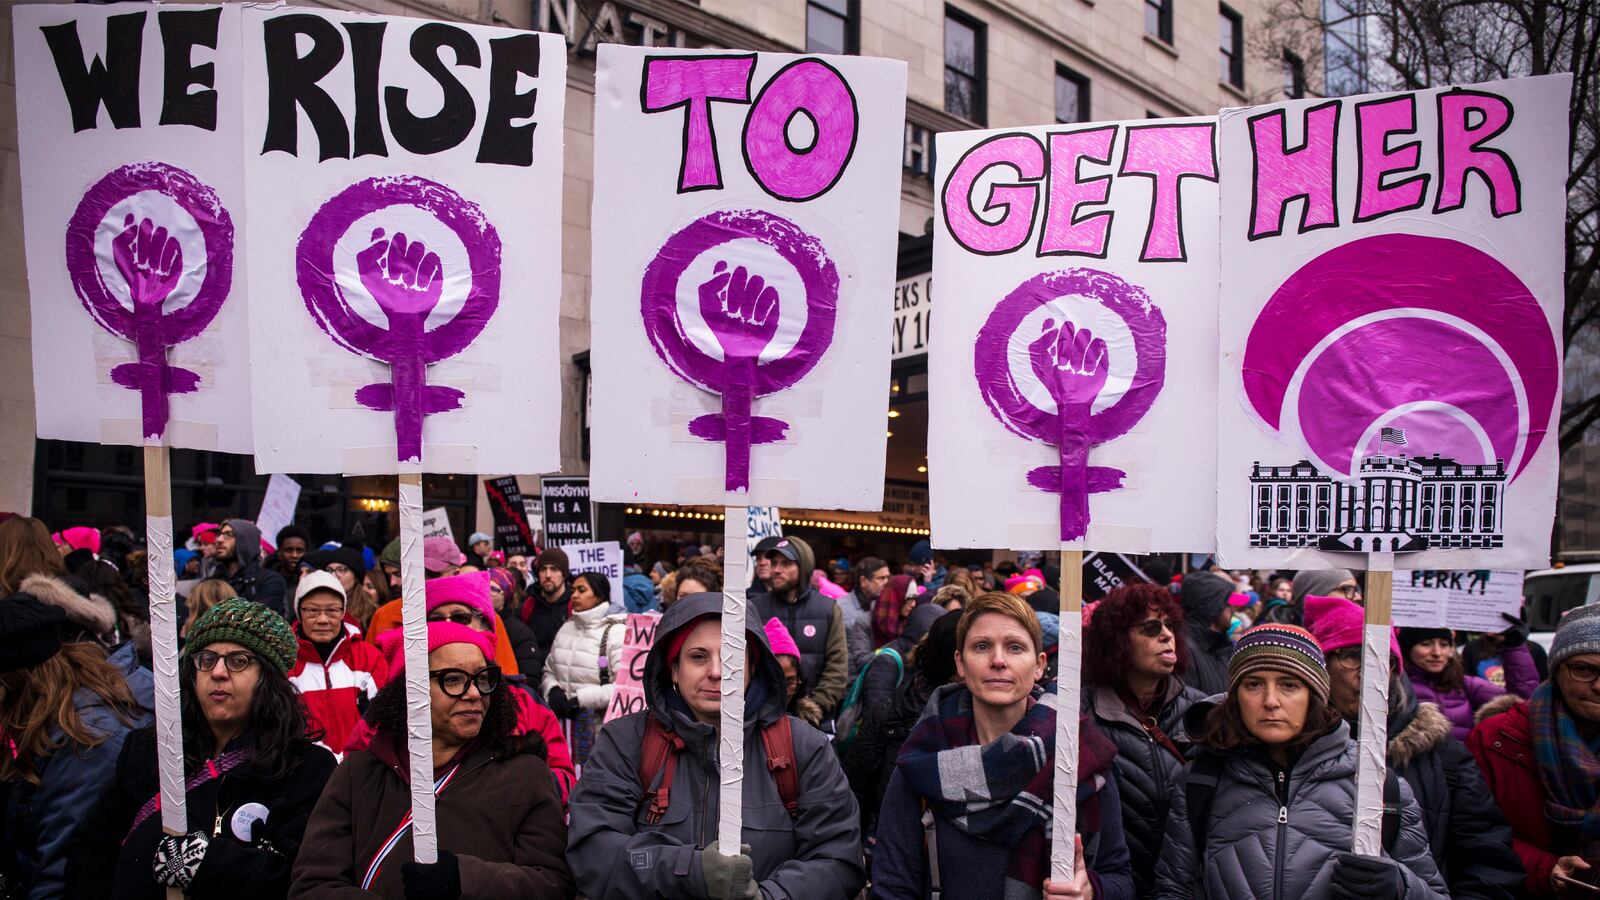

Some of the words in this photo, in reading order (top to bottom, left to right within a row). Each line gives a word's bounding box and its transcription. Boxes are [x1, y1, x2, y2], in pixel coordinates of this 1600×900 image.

[40, 7, 223, 133] WE
[260, 13, 541, 167] RISE
[640, 52, 859, 202] TO
[941, 122, 1219, 262] GET
[1247, 86, 1521, 241] HER
[548, 522, 590, 534] MENTAL
[553, 502, 565, 513] IS
[573, 502, 581, 513] A
[578, 547, 606, 563] THE
[1092, 558, 1127, 590] BLACK
